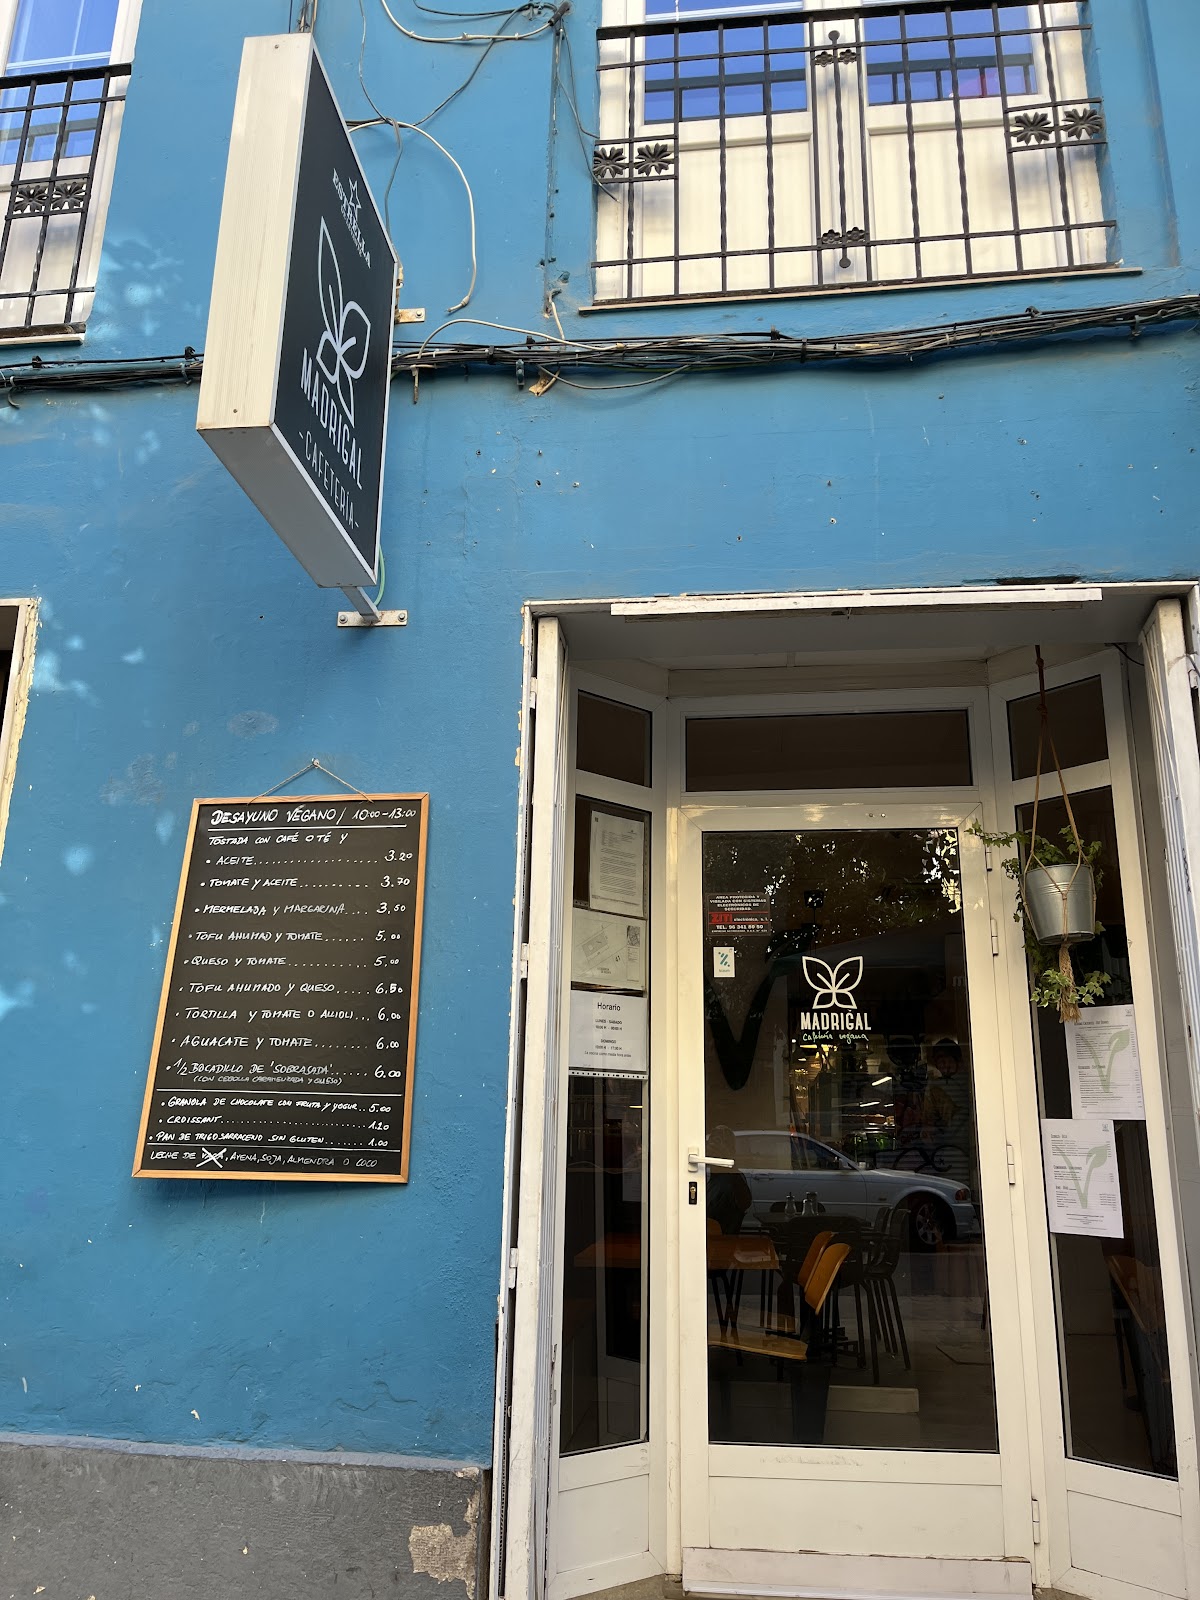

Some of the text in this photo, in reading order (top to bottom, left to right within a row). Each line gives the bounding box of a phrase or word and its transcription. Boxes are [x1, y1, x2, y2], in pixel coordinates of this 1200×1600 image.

[333, 168, 370, 268] ESTRELLA
[300, 347, 362, 490] MADRIGAL
[211, 809, 278, 825] DESAYUNO
[209, 836, 248, 845] TOSTADA
[255, 836, 271, 844] CON
[276, 832, 299, 843] CAFÉ
[317, 831, 331, 843] TÉ
[216, 850, 412, 866] ACEITE 3.20
[210, 878, 249, 887] TOMATE
[262, 878, 298, 886] ACEITE
[381, 876, 410, 887] 3.70
[203, 905, 266, 915] MERMELADA
[284, 903, 345, 915] MARGARINA
[196, 932, 223, 940] TOFU
[286, 932, 323, 940] TOMATE
[191, 956, 228, 965] QUESO
[190, 983, 222, 993] TOFU
[227, 984, 280, 992] AHUMADO
[300, 983, 334, 993] QUESO
[598, 1002, 620, 1011] Horario
[185, 1007, 236, 1019] TORTILLA
[262, 1010, 301, 1018] TOMATE
[801, 1012, 871, 1030] MADRIGAL
[180, 1035, 249, 1047] AGUACATE
[269, 1038, 312, 1046] TOMATE
[189, 1063, 243, 1073] BOCADILLO
[249, 1064, 264, 1073] DE
[168, 1096, 207, 1107] GRANOLA
[213, 1098, 226, 1106] DE
[331, 1103, 358, 1112] YOGUR
[369, 1104, 391, 1112] 5.00
[368, 1121, 389, 1130] 1.20
[156, 1131, 175, 1141] PAN
[368, 1138, 388, 1146] 1.00
[150, 1151, 179, 1160] LECHE
[287, 1155, 334, 1165] ALMENDRA
[356, 1159, 377, 1167] COCO
